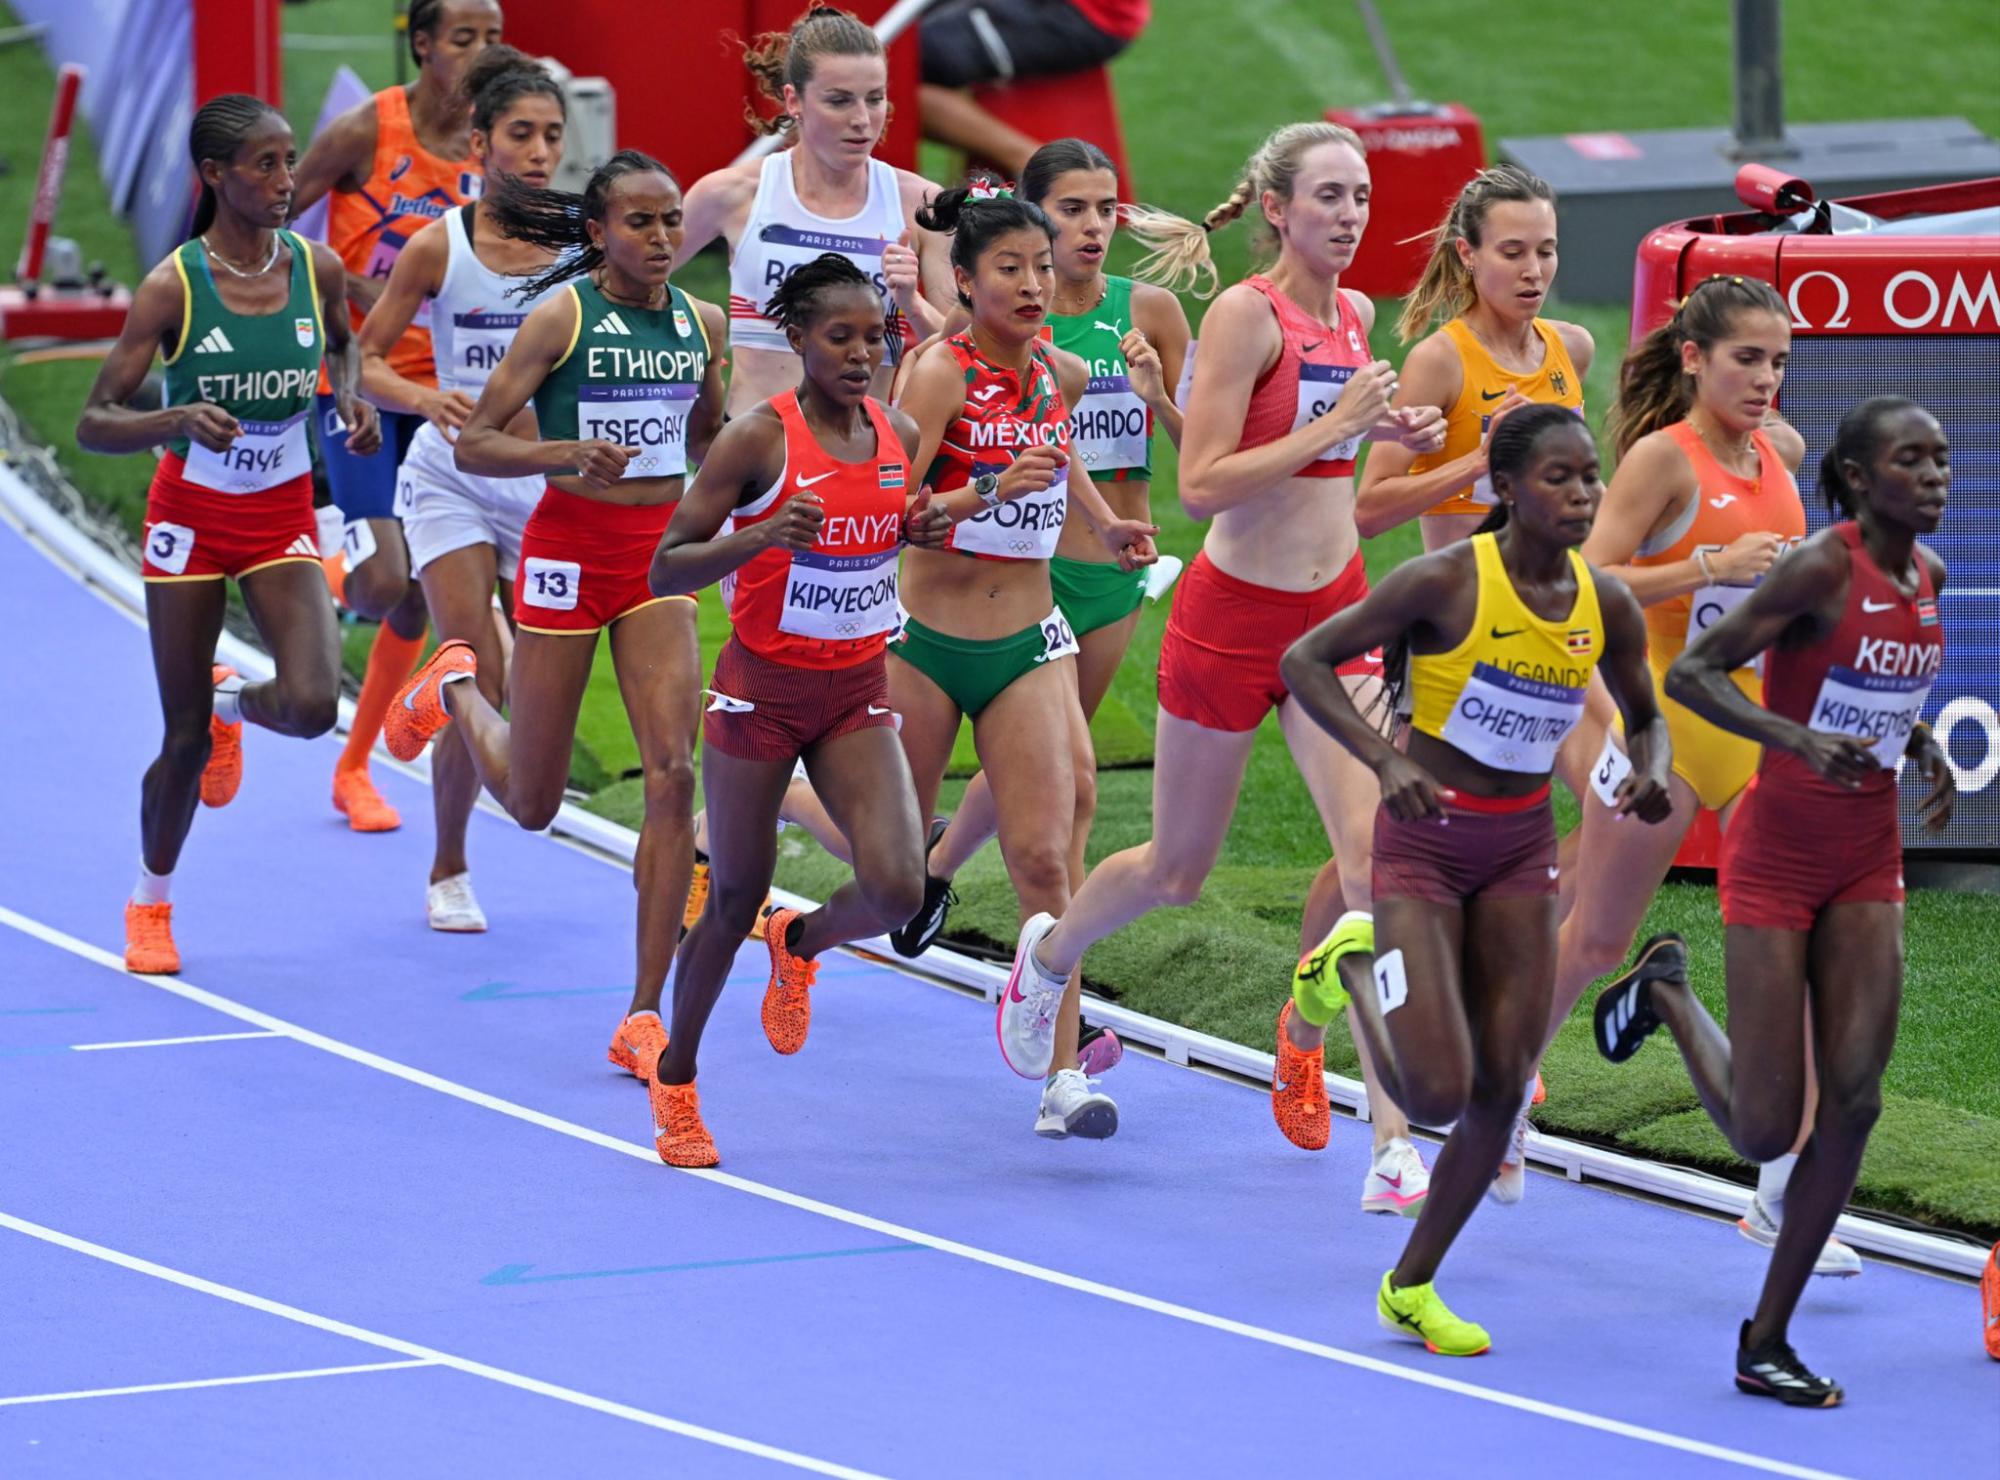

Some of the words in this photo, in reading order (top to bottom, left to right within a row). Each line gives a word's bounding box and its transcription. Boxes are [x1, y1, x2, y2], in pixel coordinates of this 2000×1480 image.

[800, 234, 832, 247] PARIS
[835, 239, 863, 250] 2024
[588, 347, 705, 381] ETHIOPIA
[198, 368, 318, 403] ETHIOPIA
[613, 389, 644, 398] PARIS
[647, 388, 673, 397] 2024
[587, 415, 684, 446] TSEGAY
[970, 418, 1069, 446] MÉXICO
[224, 444, 284, 472] TAYE
[152, 531, 177, 559] 3
[829, 559, 860, 568] PARIS
[533, 571, 568, 598] 13
[789, 572, 897, 614] KIPYEGON
[1044, 617, 1072, 652] 20
[1854, 635, 1941, 677] KENYA
[1461, 697, 1575, 744] CHEMUTAI
[1599, 754, 1615, 785] 5
